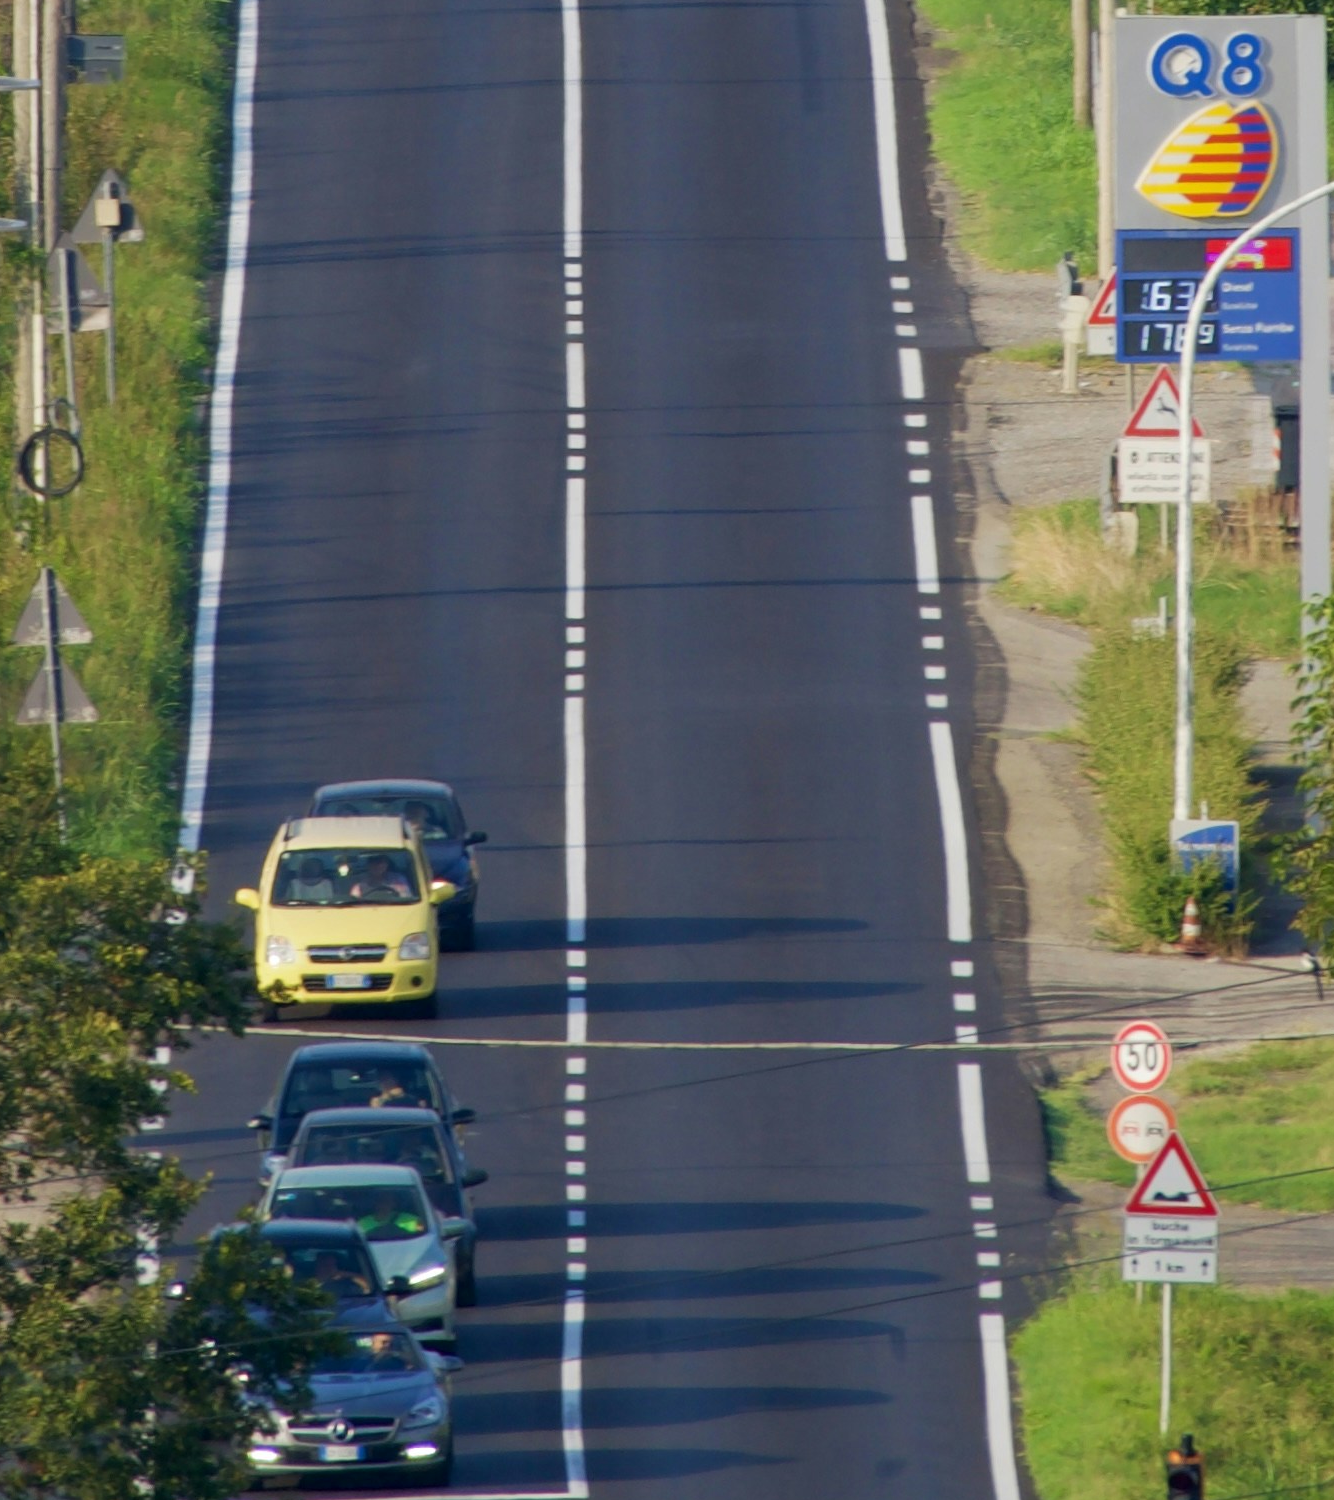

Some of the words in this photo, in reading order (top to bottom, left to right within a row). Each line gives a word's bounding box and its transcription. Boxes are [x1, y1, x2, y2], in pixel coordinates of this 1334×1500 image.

[1149, 31, 1267, 99] Q8
[1141, 280, 1214, 312] 163
[1127, 1042, 1159, 1072] 50
